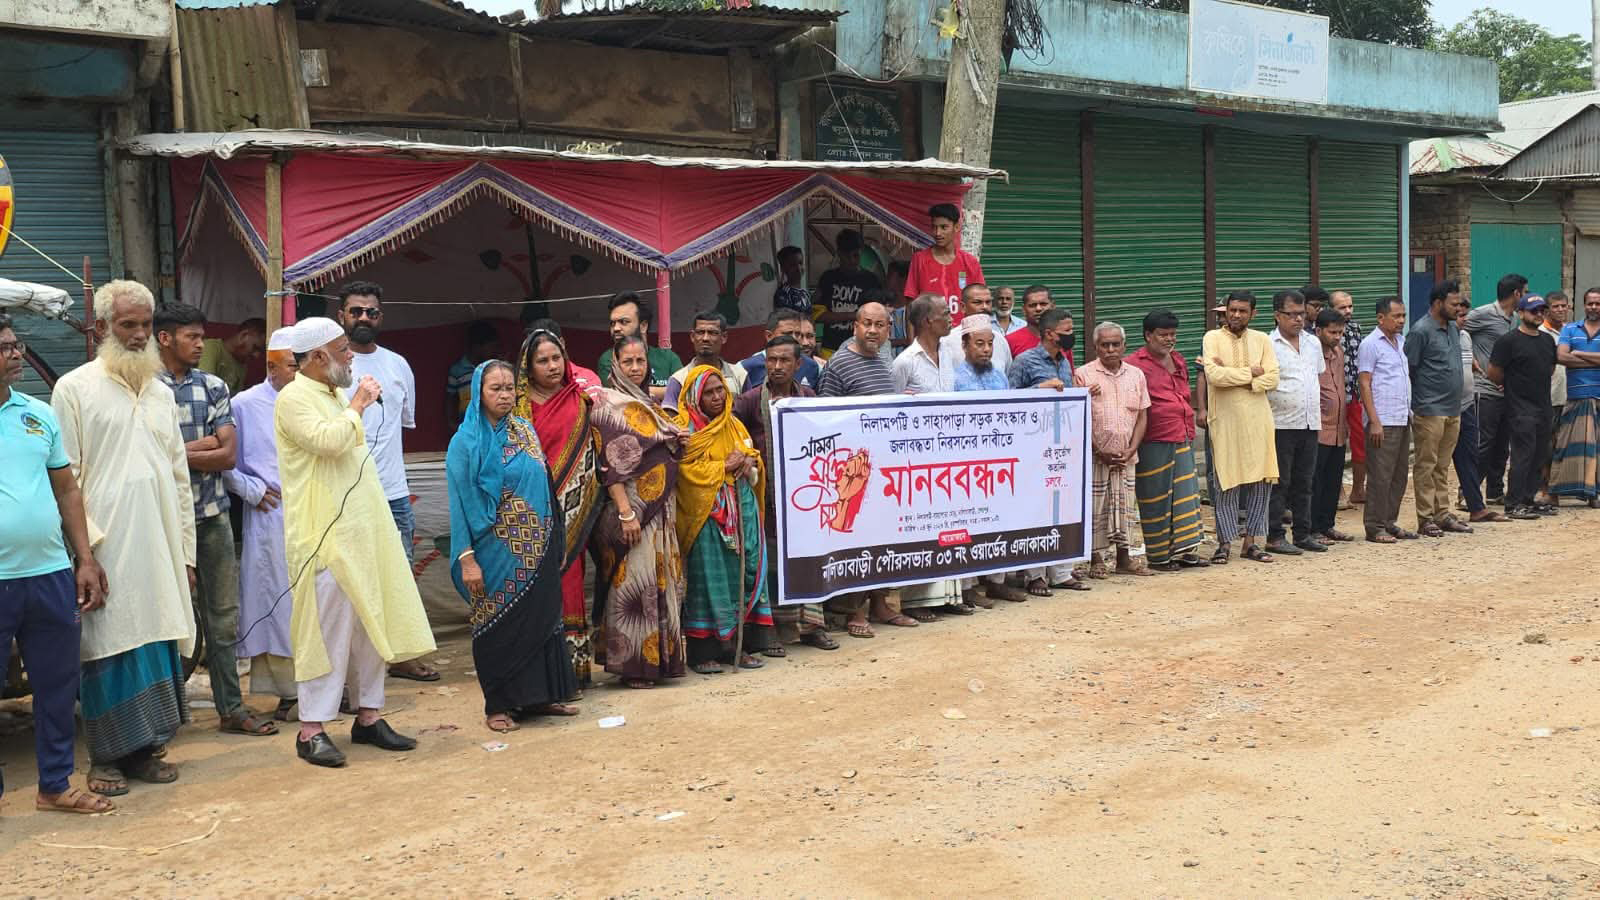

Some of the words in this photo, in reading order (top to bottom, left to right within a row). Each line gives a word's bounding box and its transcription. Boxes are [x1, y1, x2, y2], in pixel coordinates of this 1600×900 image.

[912, 416, 919, 429] ও
[922, 413, 965, 431] সাহাপাড়া
[968, 413, 993, 429] সড়ক
[996, 411, 1027, 426] সংস্কার
[1031, 411, 1038, 424] ও
[889, 437, 934, 454] জলাবদ্ধতা
[938, 432, 977, 451] নিরসনের
[981, 428, 1014, 448] দাবীতে
[879, 457, 1019, 507] মানববন্ধন
[876, 548, 934, 573] পৌরসভার
[936, 549, 952, 565] ০৩
[954, 545, 968, 564] নং
[970, 534, 1008, 560] ওয়ার্ডের
[1010, 528, 1061, 556] এলাকাবাসী
